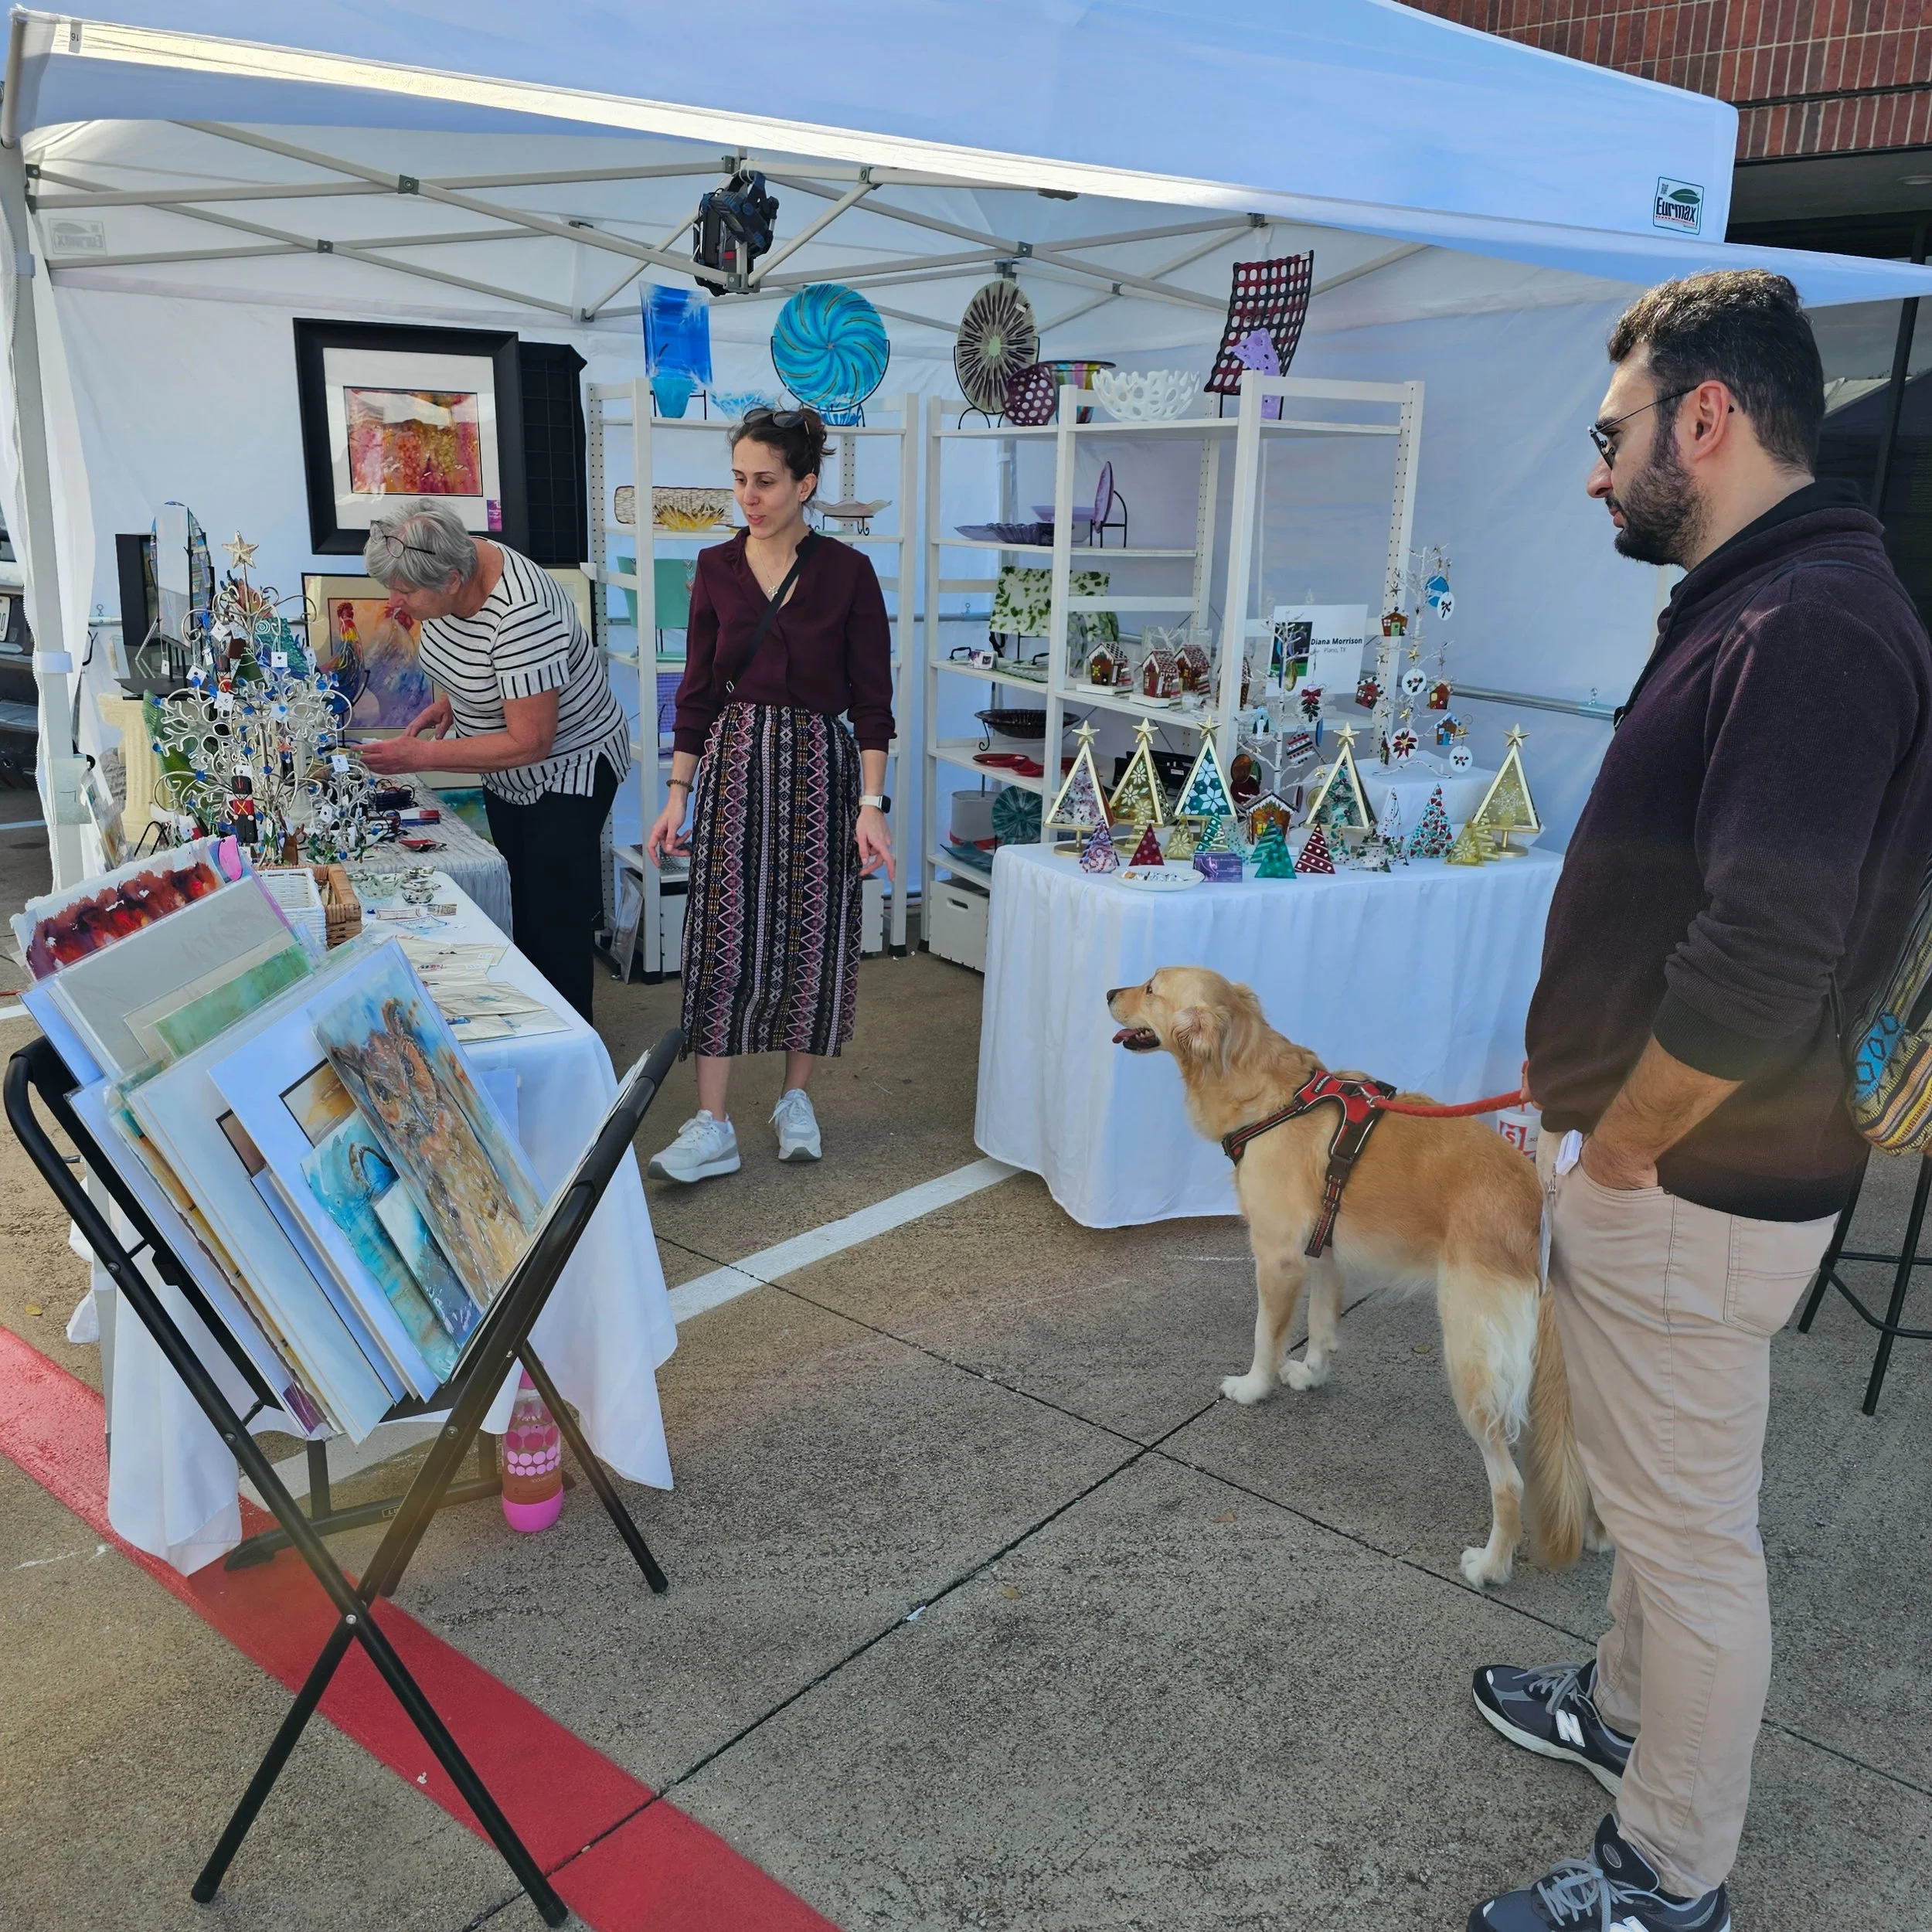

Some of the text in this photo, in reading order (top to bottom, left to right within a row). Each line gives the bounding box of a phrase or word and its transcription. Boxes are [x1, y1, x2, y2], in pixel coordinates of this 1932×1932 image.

[1656, 196, 1696, 223] Eurmax
[1332, 637, 1362, 645] Morrison
[1555, 1709, 1585, 1747] N
